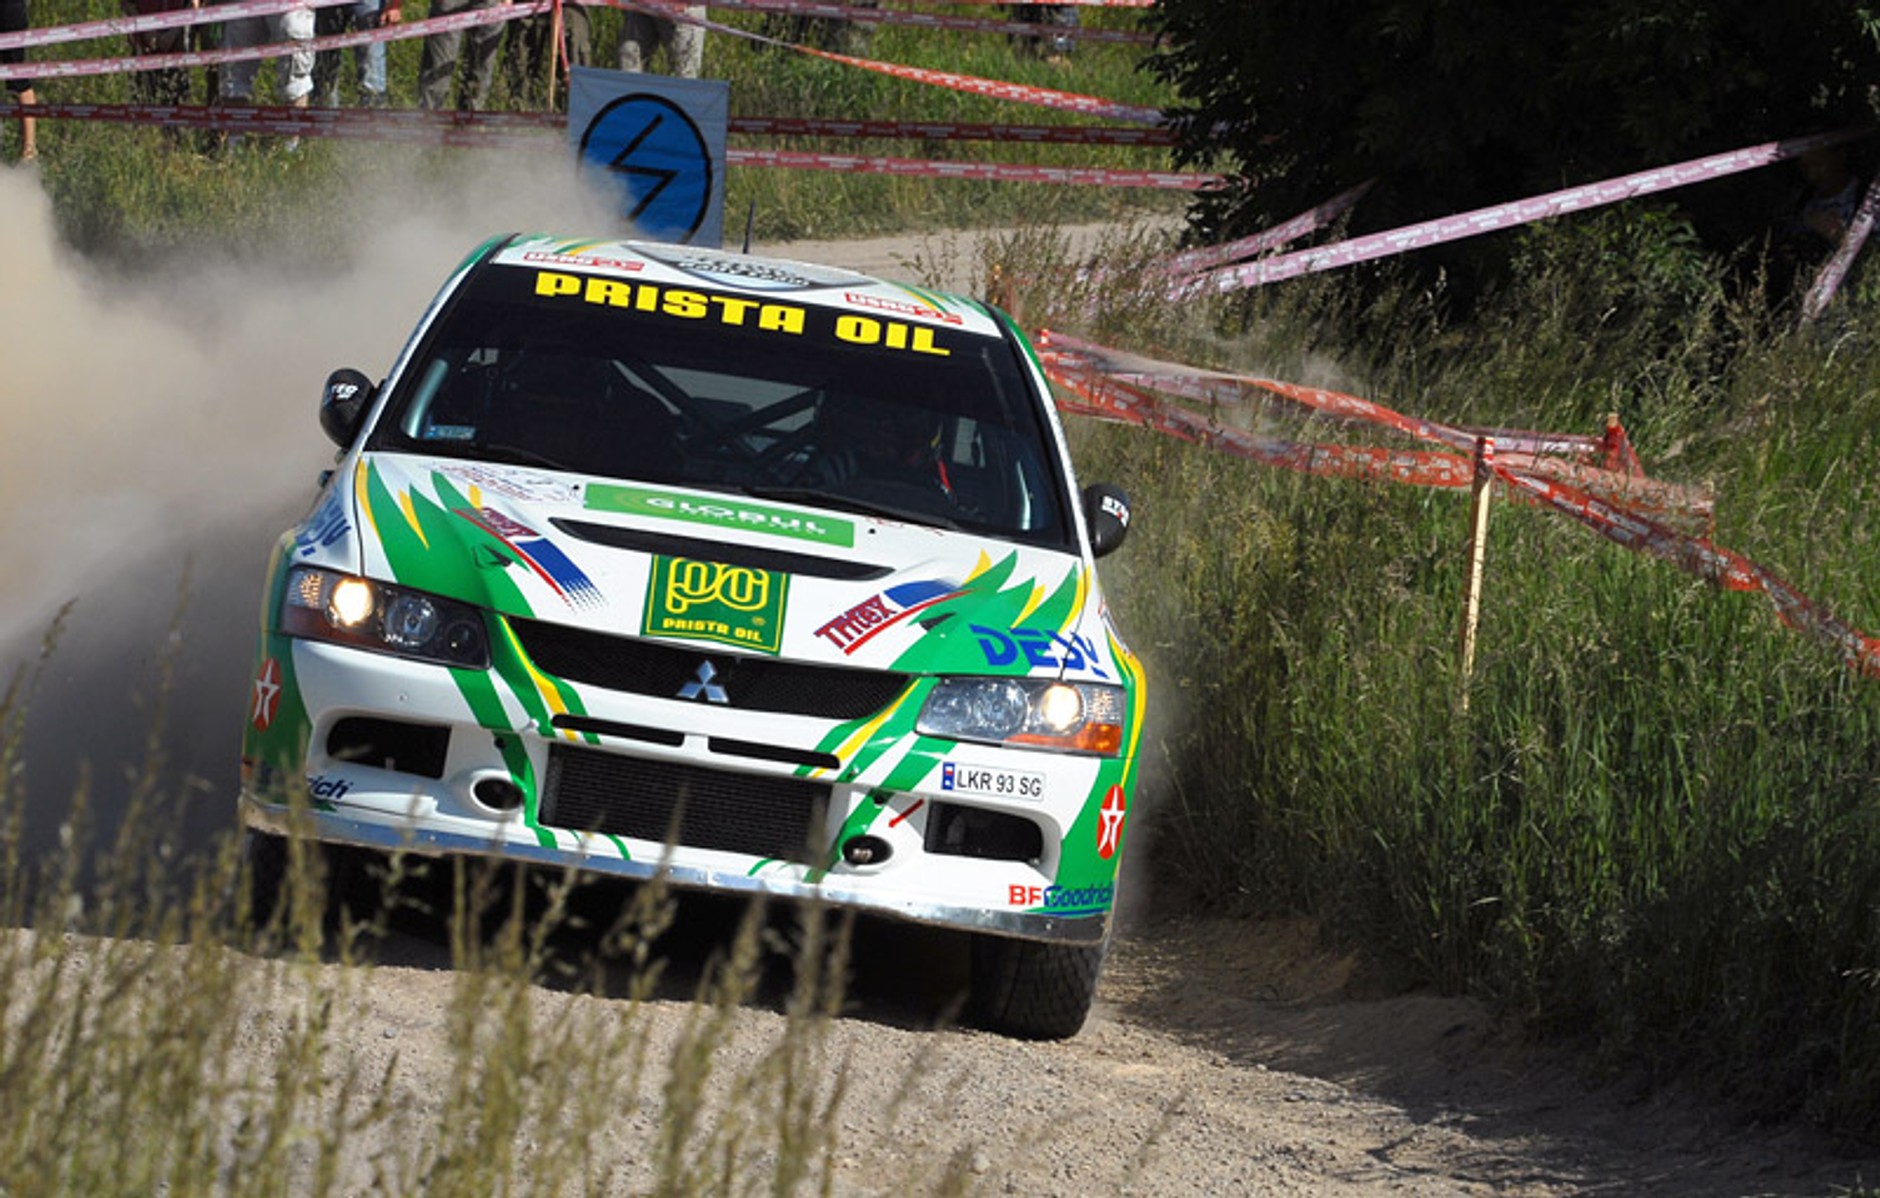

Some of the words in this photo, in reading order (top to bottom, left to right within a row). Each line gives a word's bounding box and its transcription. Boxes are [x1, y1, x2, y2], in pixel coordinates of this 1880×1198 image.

[534, 271, 806, 335] PRISTA
[835, 315, 951, 356] OIL
[662, 617, 730, 635] PRISTA
[733, 626, 763, 643] OIL
[956, 770, 992, 791] LKR
[996, 774, 1015, 794] 93
[1019, 777, 1042, 797] SG
